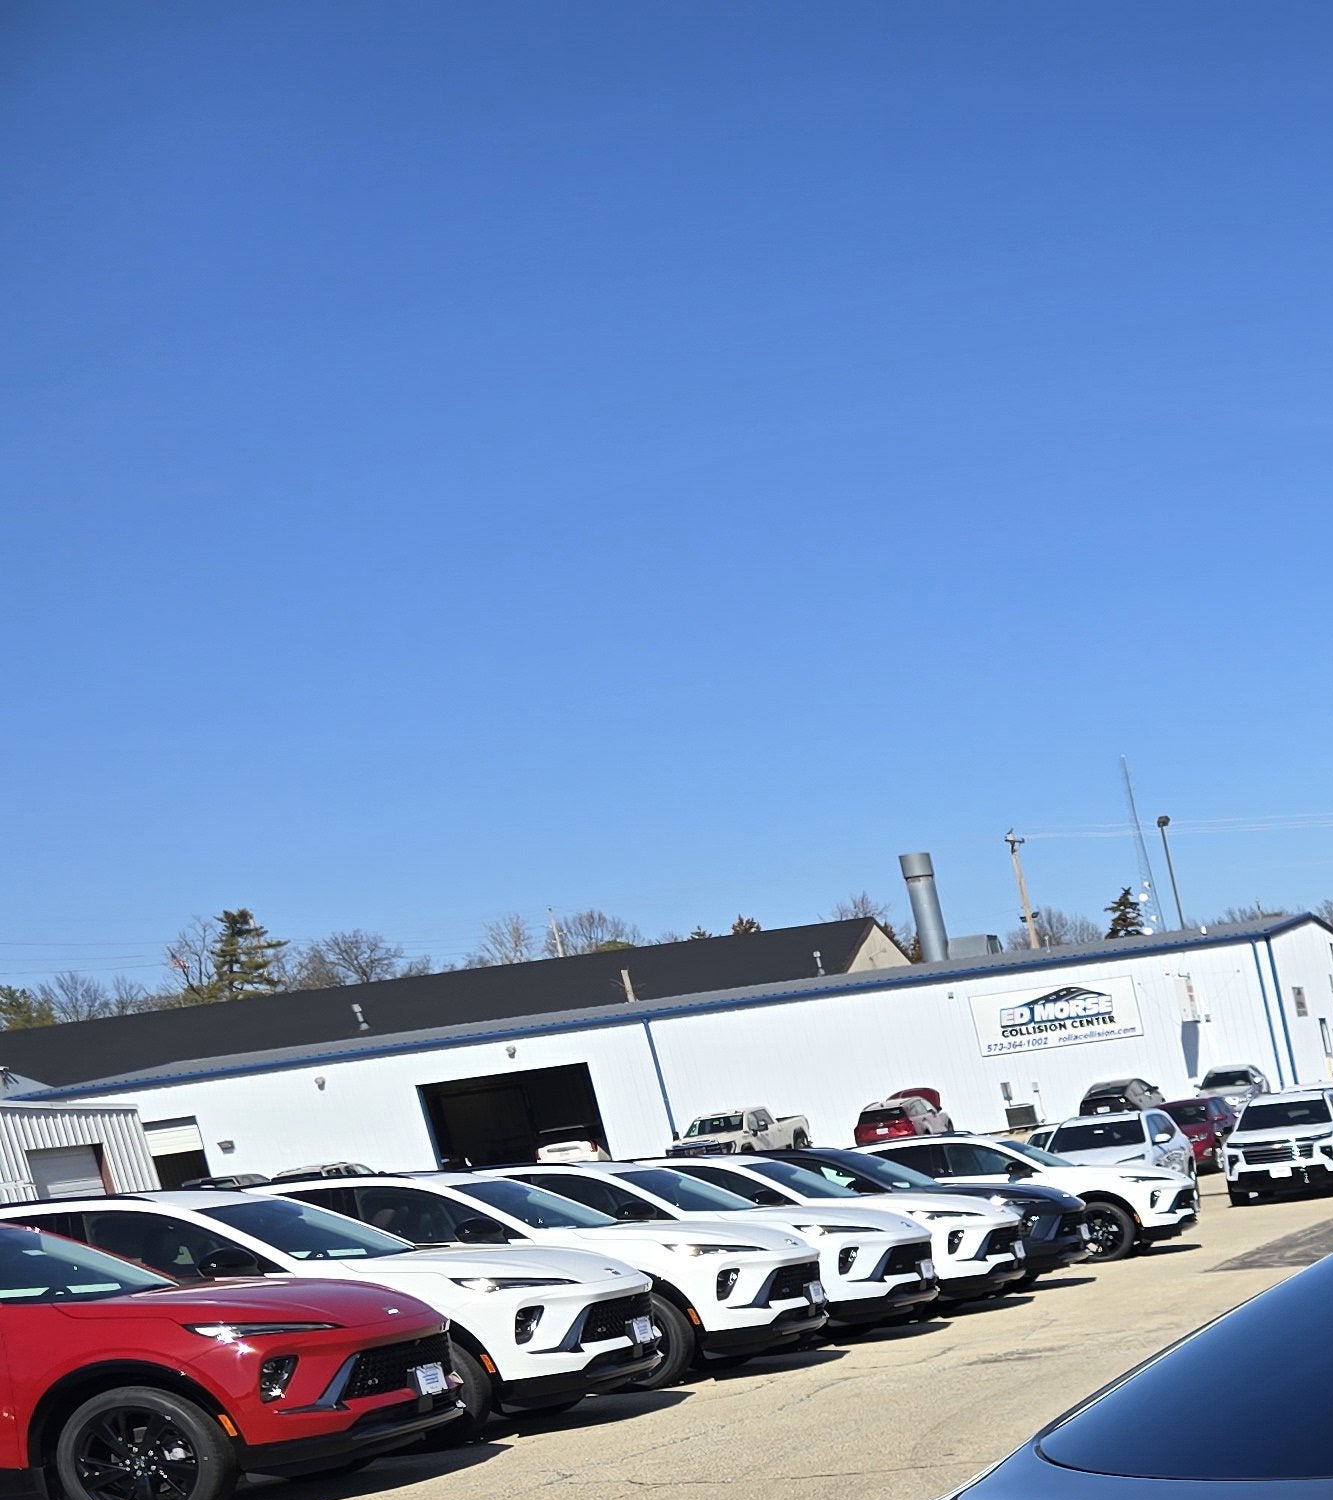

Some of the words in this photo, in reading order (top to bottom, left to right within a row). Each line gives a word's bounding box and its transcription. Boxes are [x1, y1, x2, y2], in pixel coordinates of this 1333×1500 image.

[1000, 1006, 1032, 1028] ED
[1033, 995, 1113, 1024] MORSE
[1001, 1021, 1067, 1038] COLLISION
[1071, 1015, 1117, 1031] CENTER
[987, 1036, 1049, 1053] 573-364-1002
